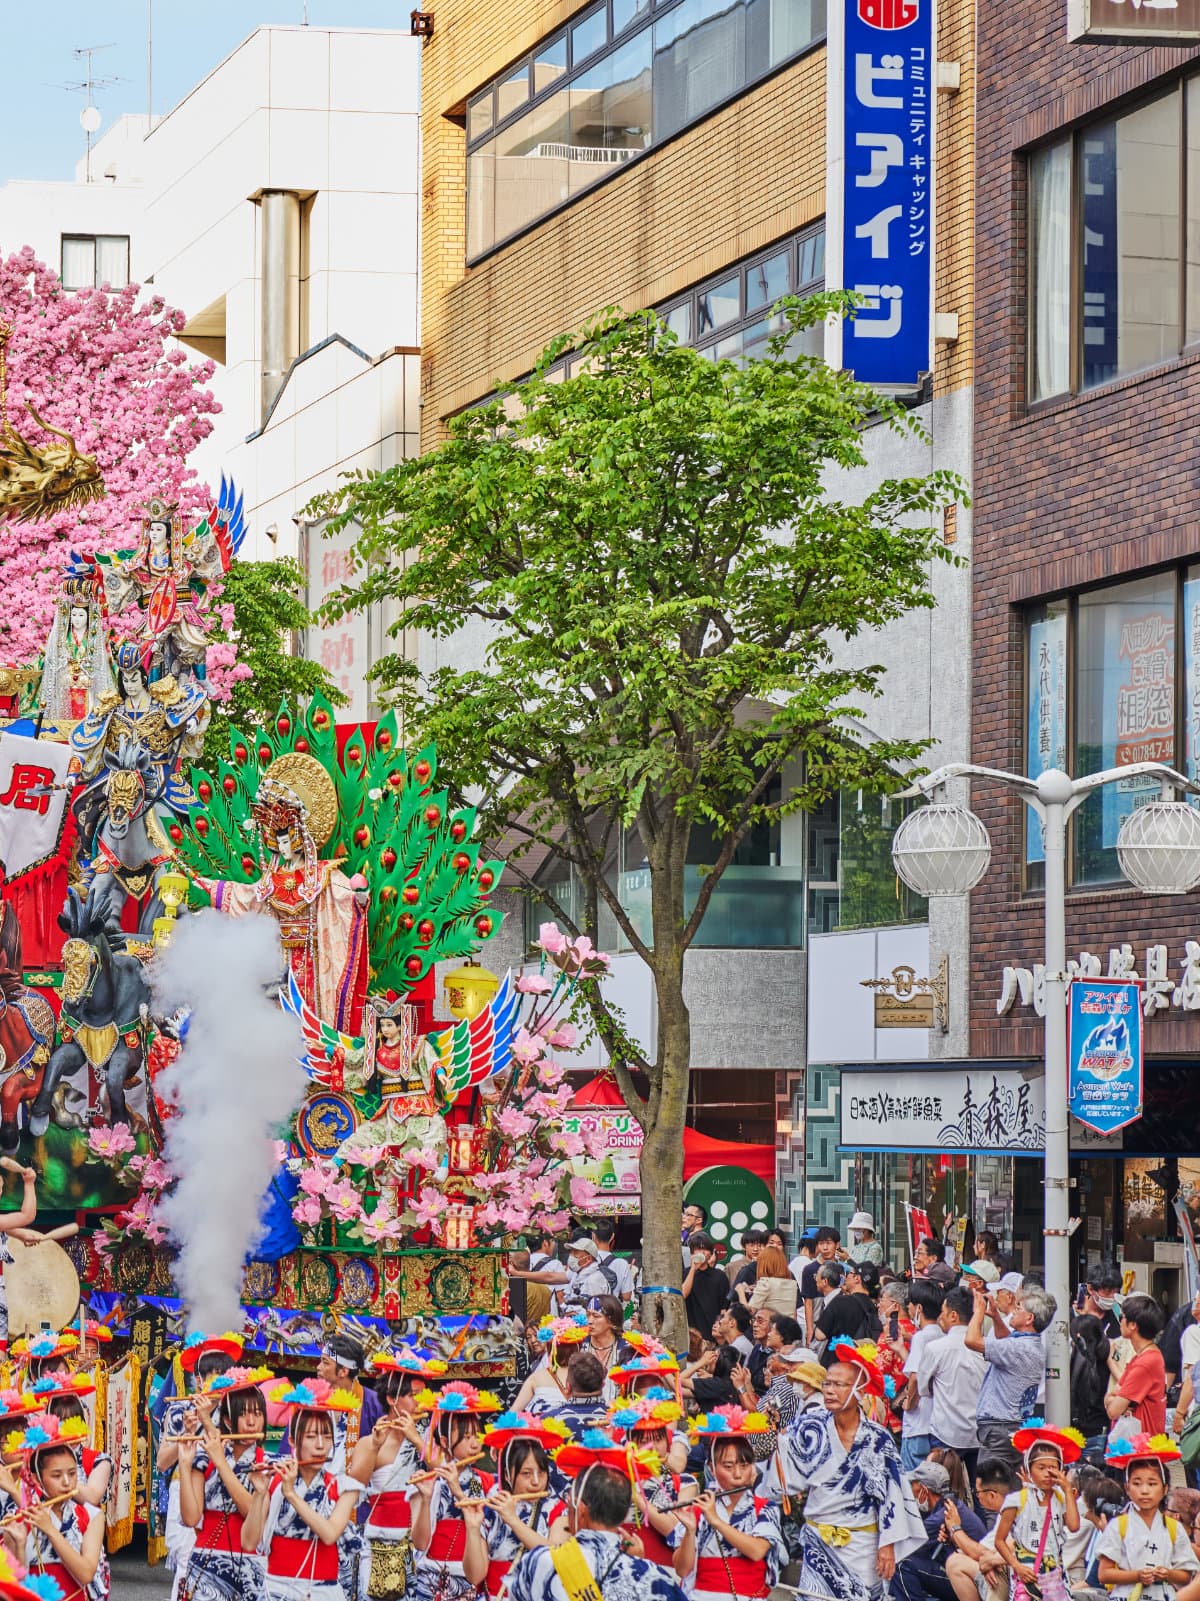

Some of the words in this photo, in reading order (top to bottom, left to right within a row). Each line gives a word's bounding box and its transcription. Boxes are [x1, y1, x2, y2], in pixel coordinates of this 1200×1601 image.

[909, 47, 926, 147] コミュニティ
[853, 53, 905, 340] ビアイジ
[909, 154, 926, 257] キャッシング
[0, 763, 55, 815] 周
[958, 1075, 1033, 1146] 青森屋
